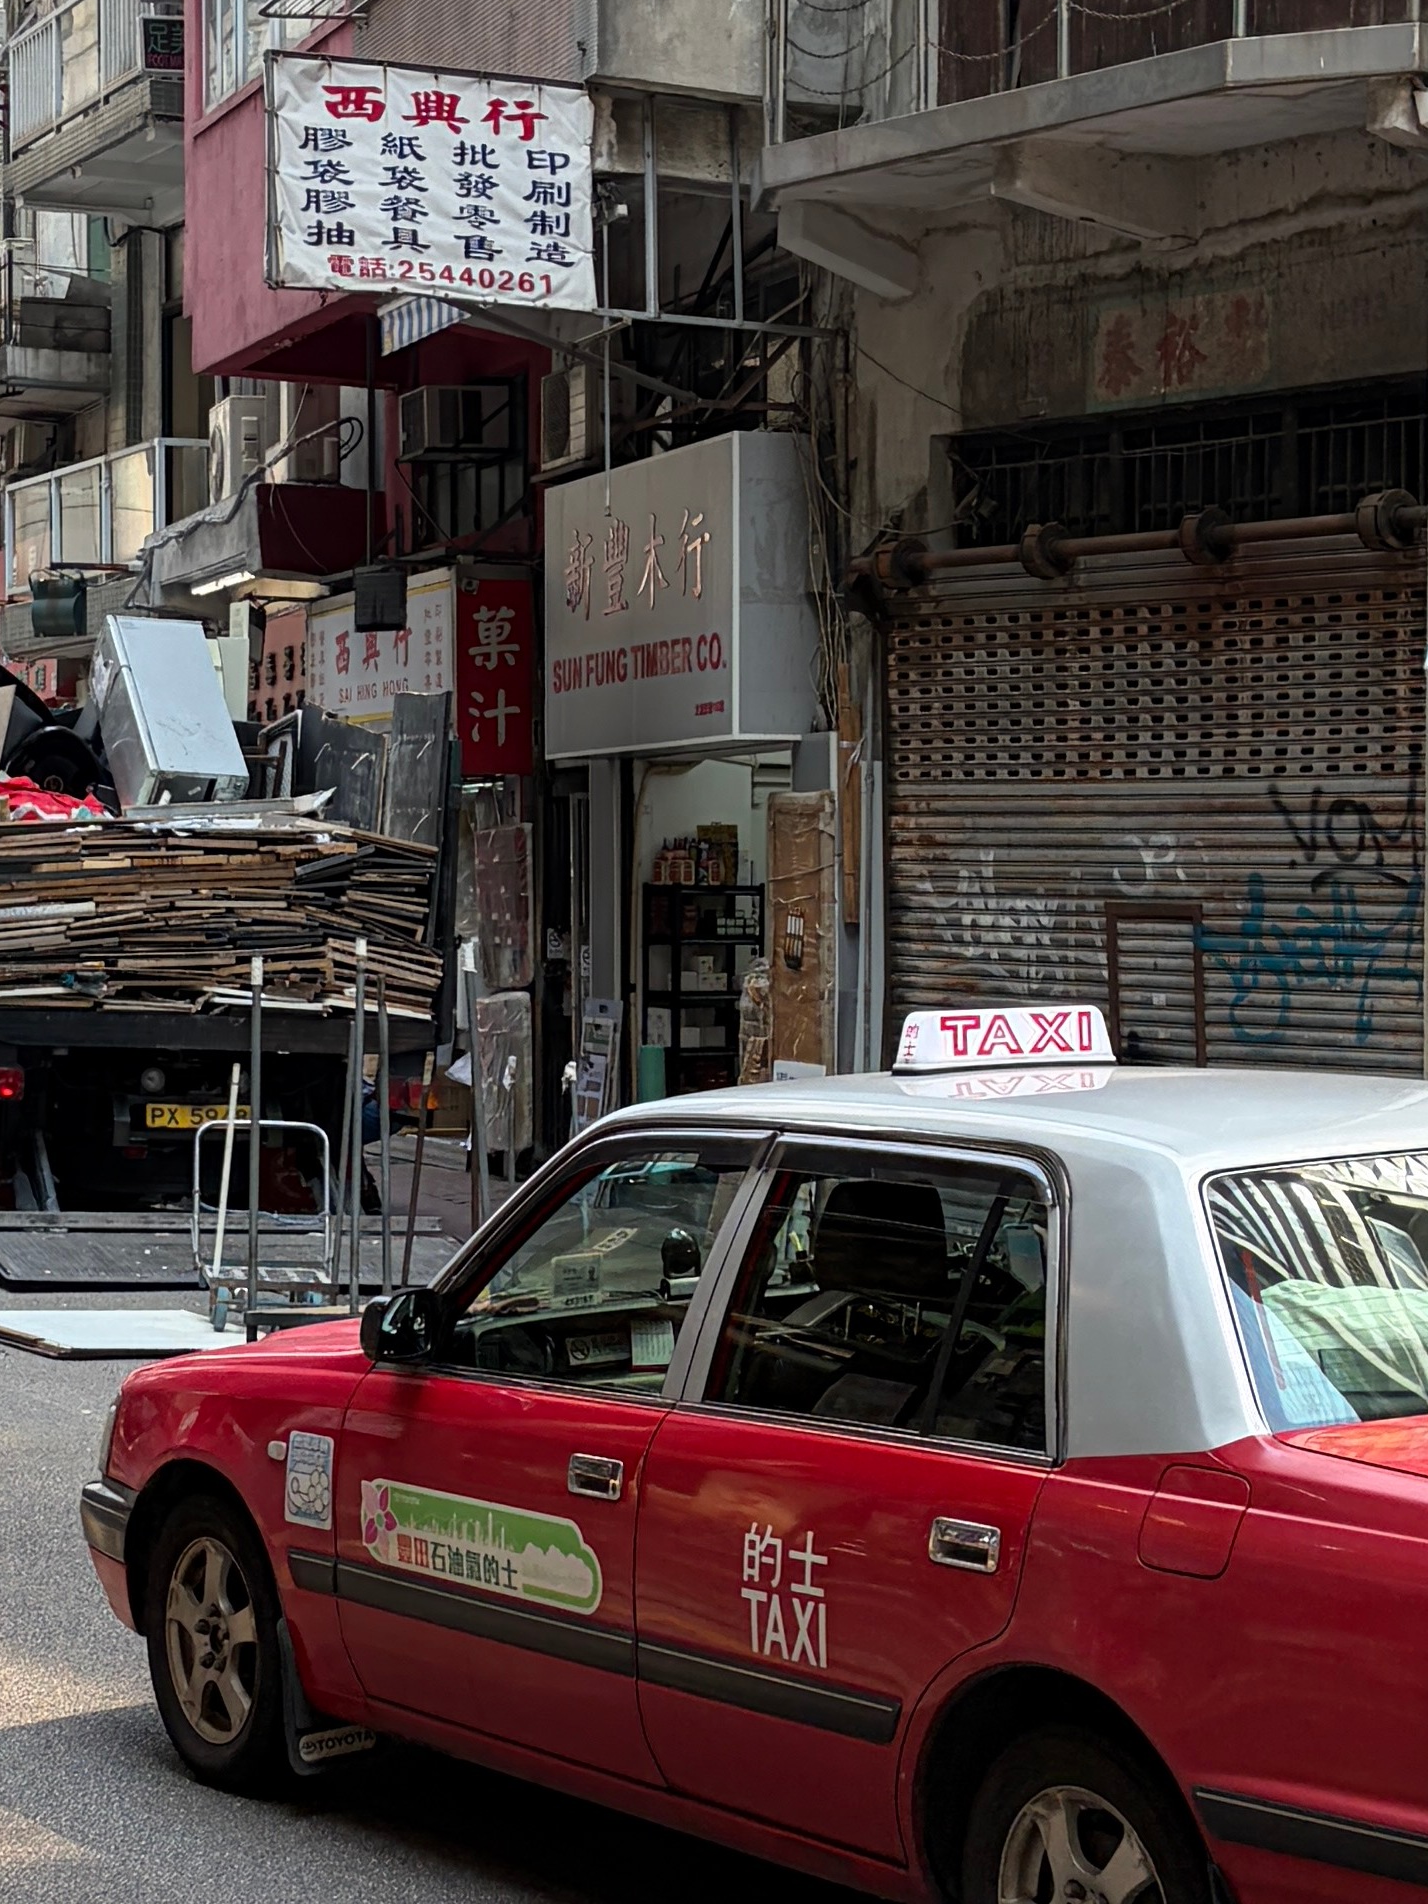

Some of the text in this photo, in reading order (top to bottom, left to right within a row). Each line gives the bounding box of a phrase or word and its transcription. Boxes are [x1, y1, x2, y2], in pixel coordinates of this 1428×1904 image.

[323, 84, 548, 142] 西興行
[468, 605, 521, 748] 菓汁
[553, 632, 727, 694] SUN FUNG TIMBER CO.
[940, 1011, 1093, 1057] TAXI
[151, 1107, 179, 1125] PX
[742, 1522, 830, 1598] 的士
[741, 1587, 828, 1669] TAXI
[317, 1730, 375, 1752] TOYOTA
